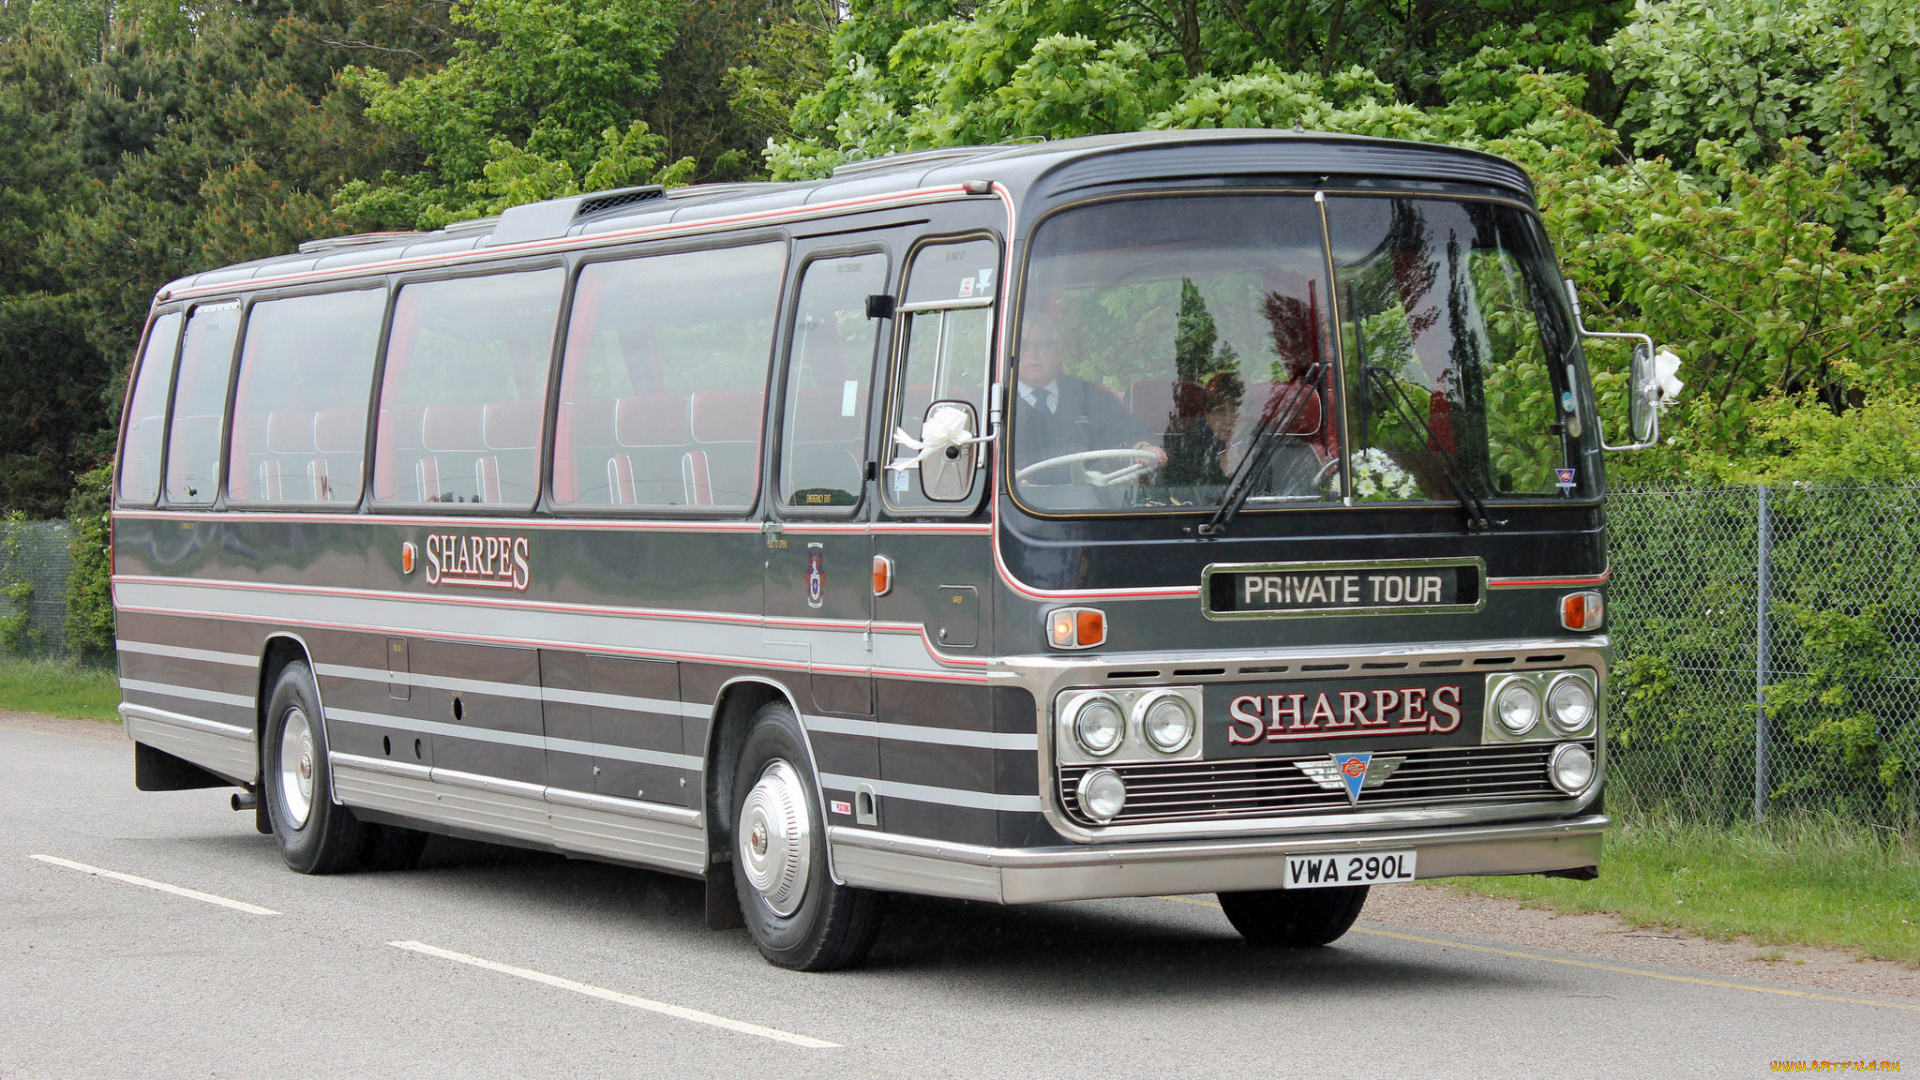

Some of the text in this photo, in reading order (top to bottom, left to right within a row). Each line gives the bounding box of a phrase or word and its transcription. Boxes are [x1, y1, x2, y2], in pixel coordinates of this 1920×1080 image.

[425, 532, 529, 591] SHARPES
[1244, 576, 1442, 604] PRIVATE TOUR
[1228, 685, 1462, 744] SHARPES
[1290, 855, 1412, 884] VWA 290L
